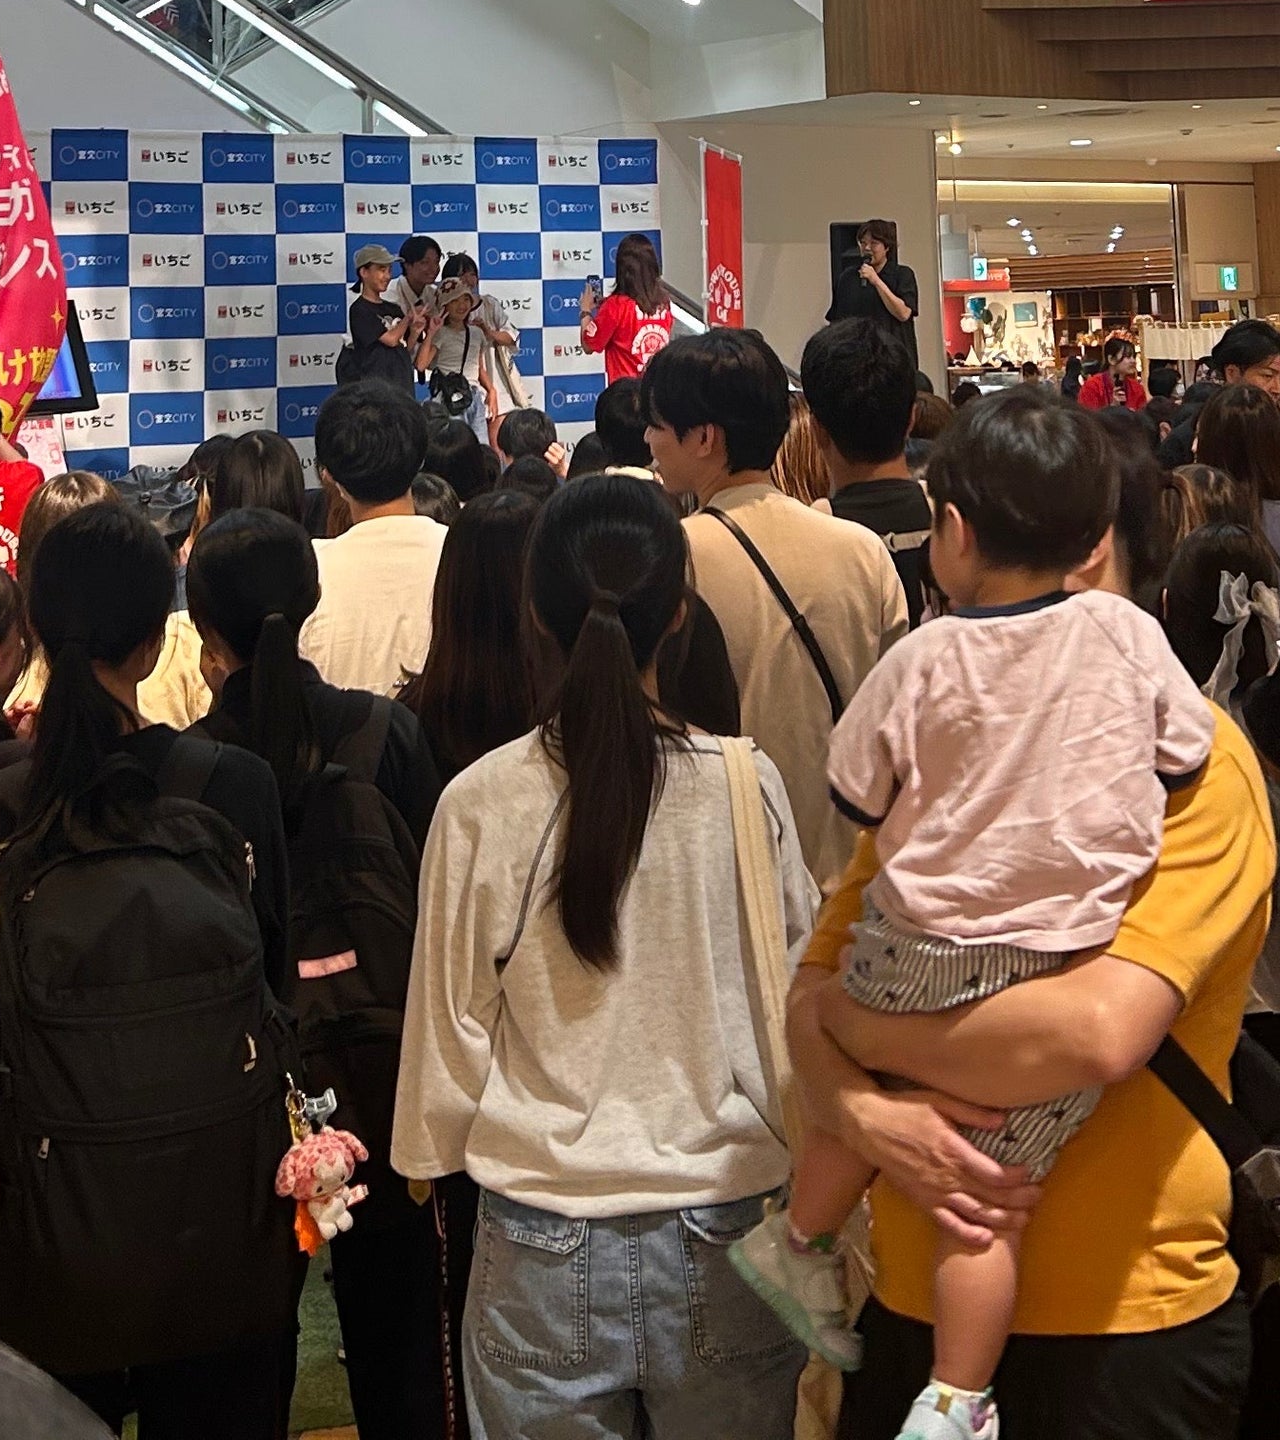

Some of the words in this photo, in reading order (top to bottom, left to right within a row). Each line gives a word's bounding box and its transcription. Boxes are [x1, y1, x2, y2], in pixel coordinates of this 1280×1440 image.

[153, 150, 190, 163] いちご
[297, 152, 332, 165] いちご
[431, 153, 464, 167] いちご
[558, 155, 588, 168] いちご
[77, 201, 115, 214] いちご
[227, 202, 263, 215] いちご
[367, 202, 400, 215] いちご
[497, 202, 529, 215] いちご
[620, 201, 651, 213] いちご
[154, 254, 191, 267] いちご
[299, 252, 334, 265] いちご
[562, 249, 592, 261] いちご
[500, 297, 532, 310] いちご
[79, 308, 116, 320] いちご
[229, 304, 265, 318] いちご
[155, 359, 192, 372] いちご
[300, 352, 336, 366] いちご
[77, 414, 115, 428] いちご
[229, 408, 264, 421] いちご
